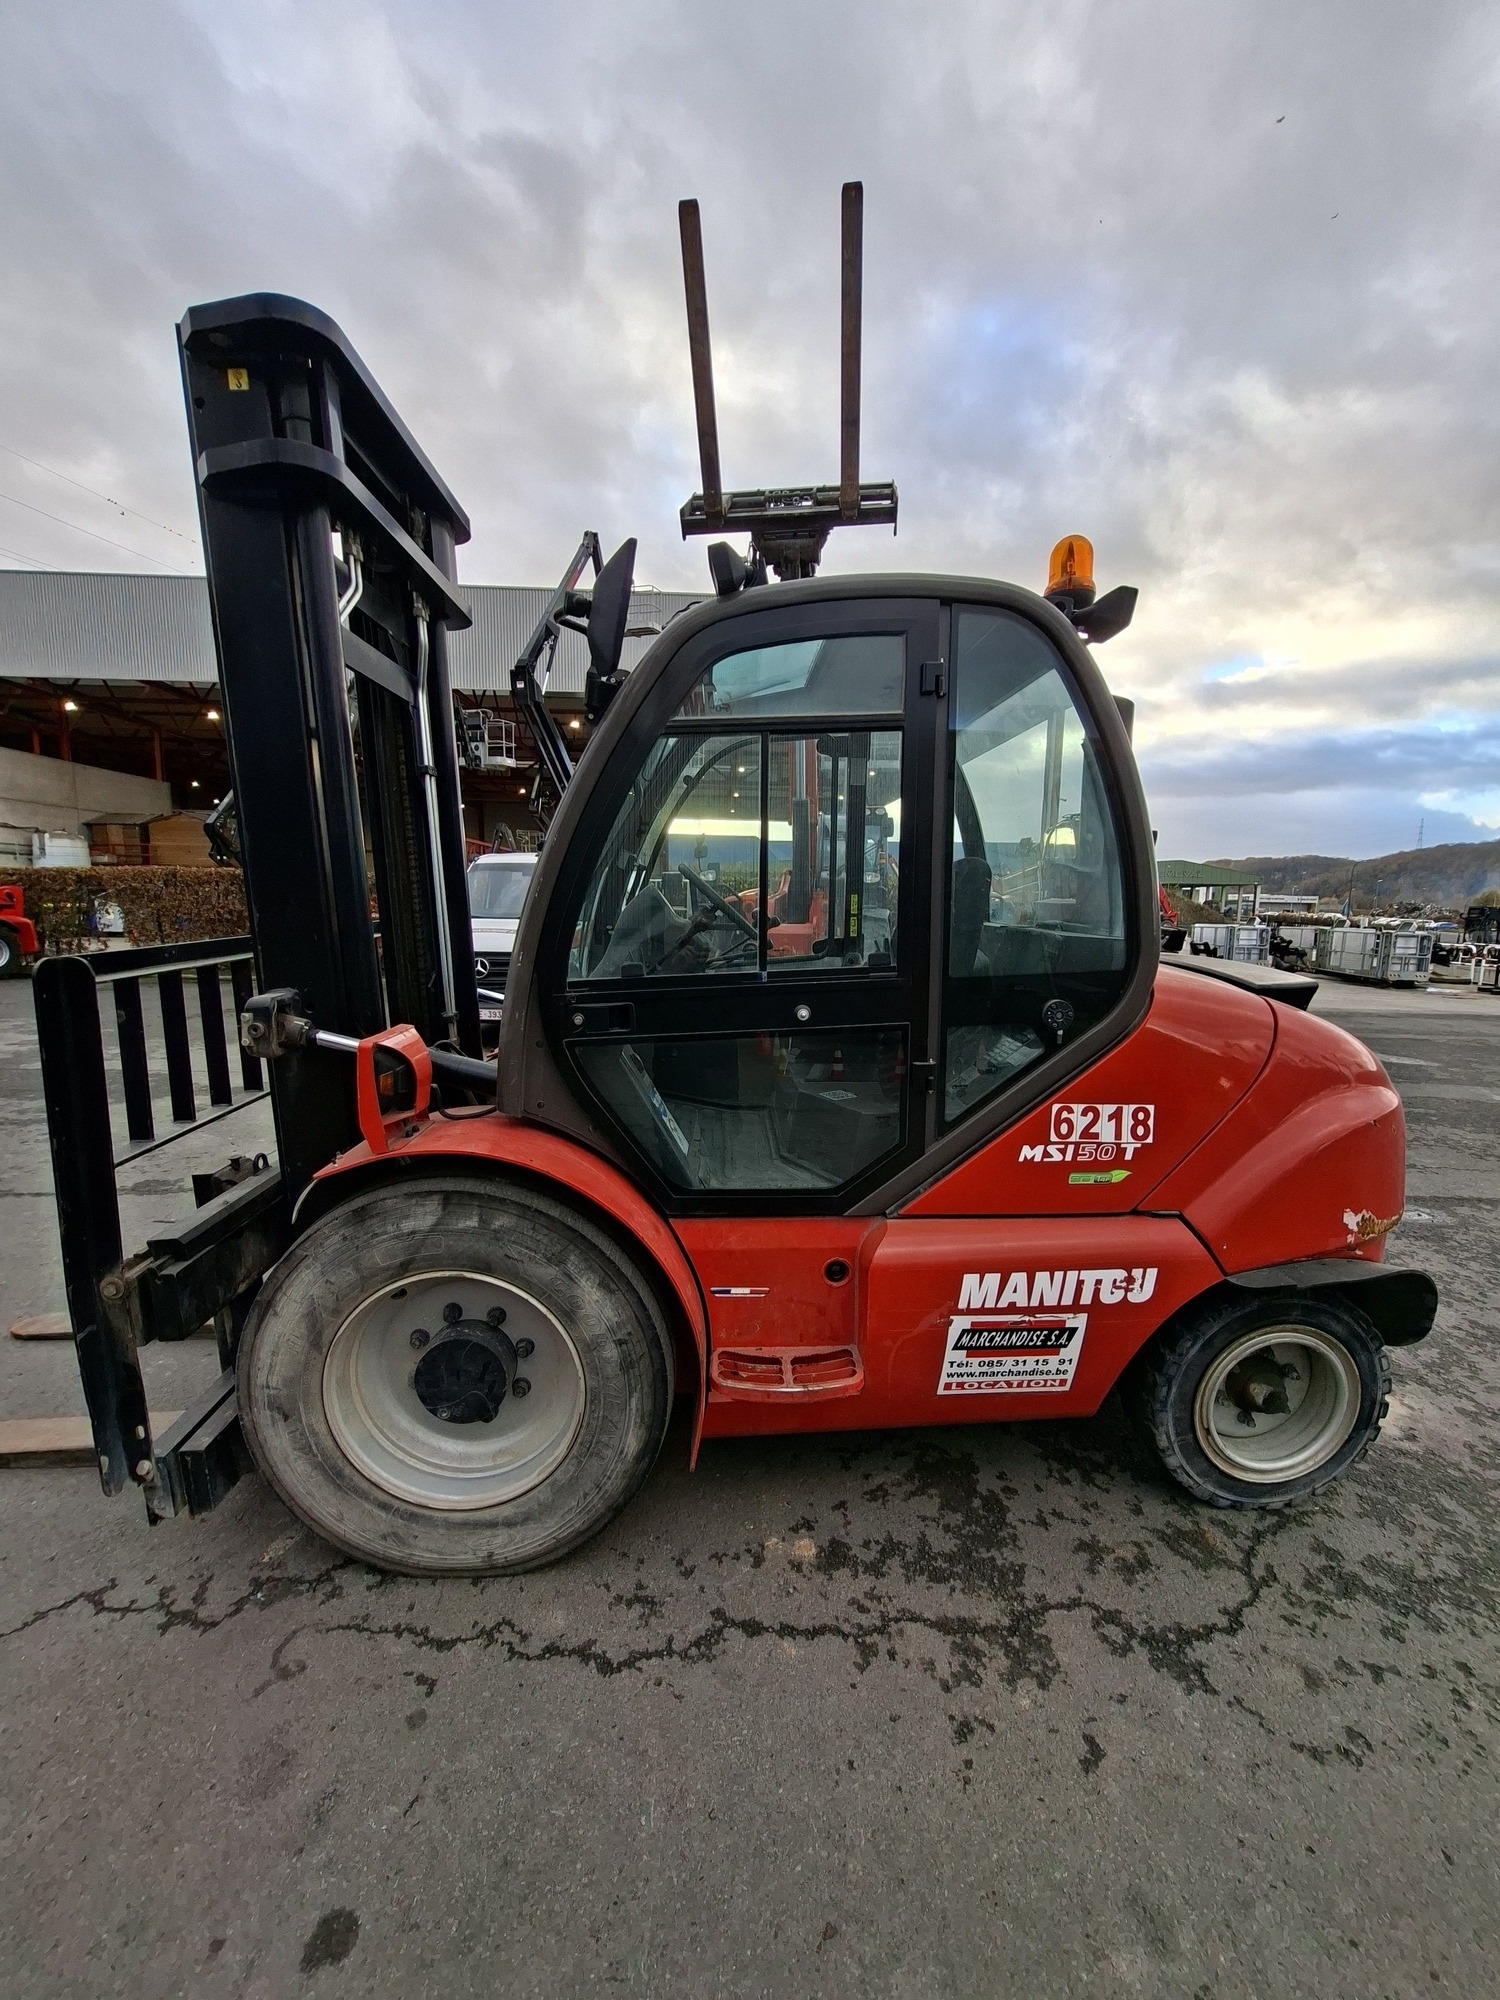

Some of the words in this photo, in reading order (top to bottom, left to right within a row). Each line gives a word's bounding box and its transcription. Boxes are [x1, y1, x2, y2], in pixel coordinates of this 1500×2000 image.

[1053, 1105, 1151, 1142] 6218
[958, 1268, 1158, 1309] MANITOU
[957, 1330, 1048, 1347] MARCHANDISE
[1047, 1330, 1070, 1346] S.A.
[948, 1360, 973, 1369] Tél:
[978, 1359, 1007, 1368] 085/
[1033, 1358, 1049, 1366] 15
[1058, 1358, 1073, 1366] 91
[946, 1368, 1069, 1379] www.marchandise.be
[951, 1380, 1060, 1390] LOCATION
